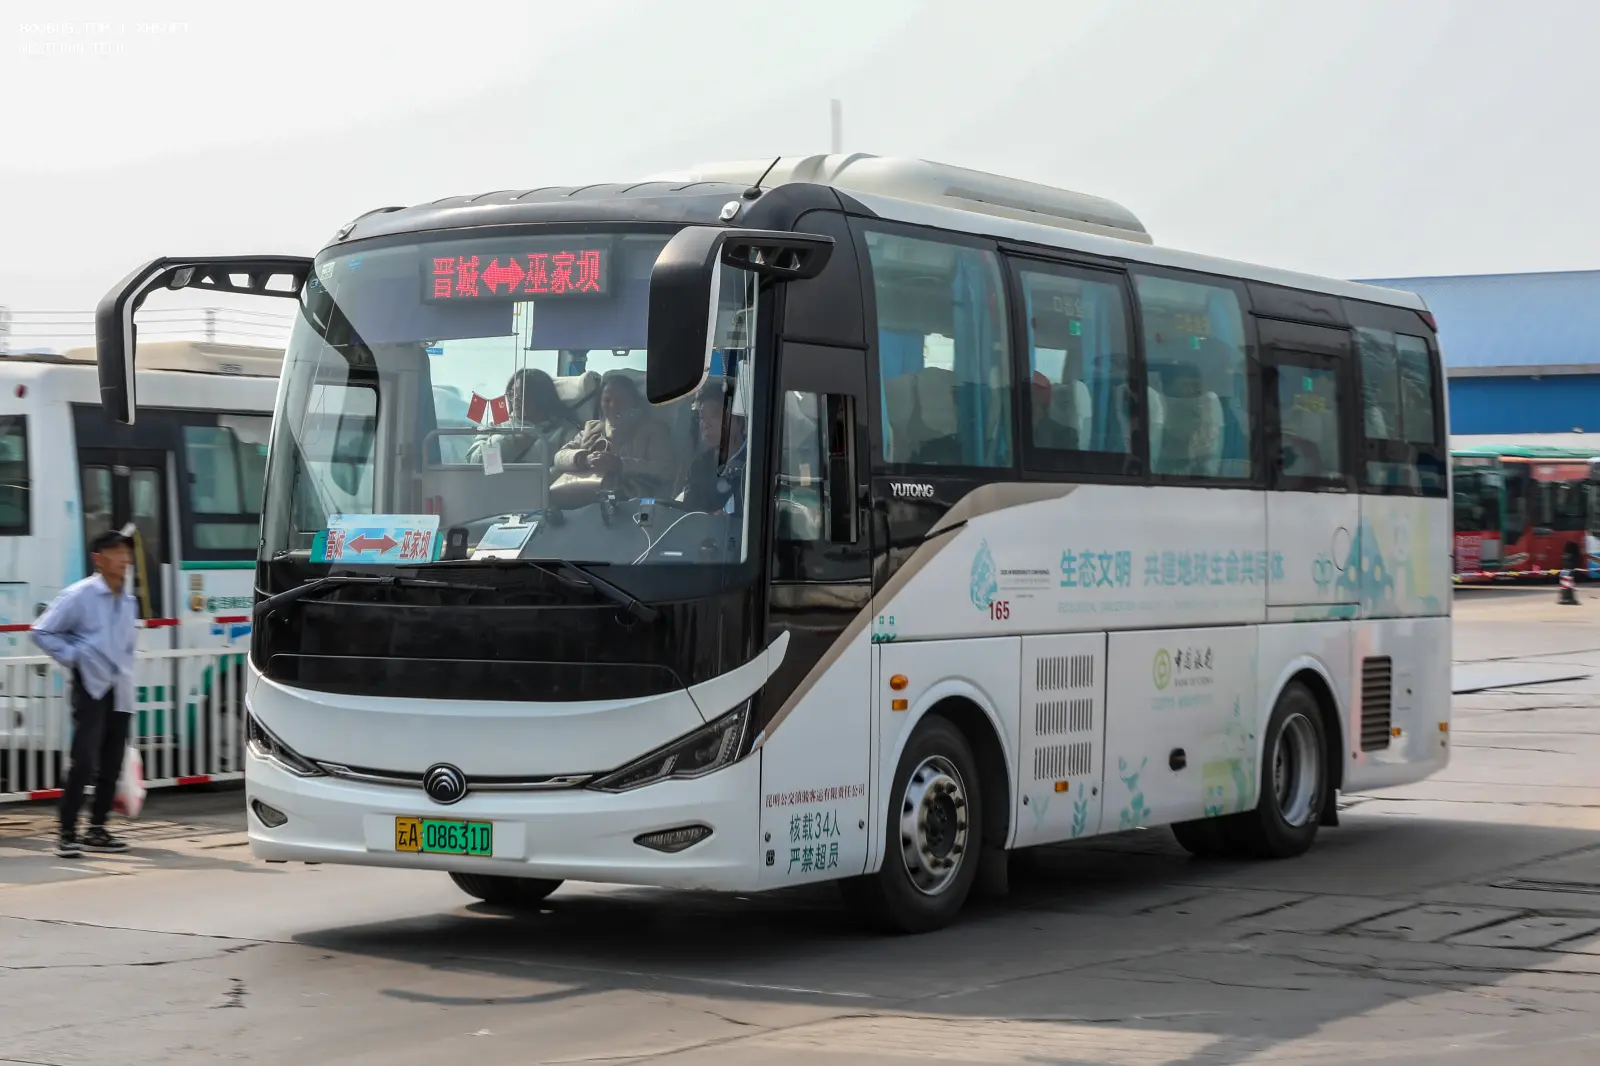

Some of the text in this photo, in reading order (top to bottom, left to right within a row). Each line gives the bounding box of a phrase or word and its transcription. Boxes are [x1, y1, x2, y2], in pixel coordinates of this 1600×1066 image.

[432, 250, 601, 298] 晋城 巫家坝
[889, 482, 935, 498] YUTONG
[1059, 549, 1132, 588] 生态文明
[988, 601, 1010, 620] 165
[789, 809, 841, 843] 核载34人
[787, 842, 839, 875] 严禁超员
